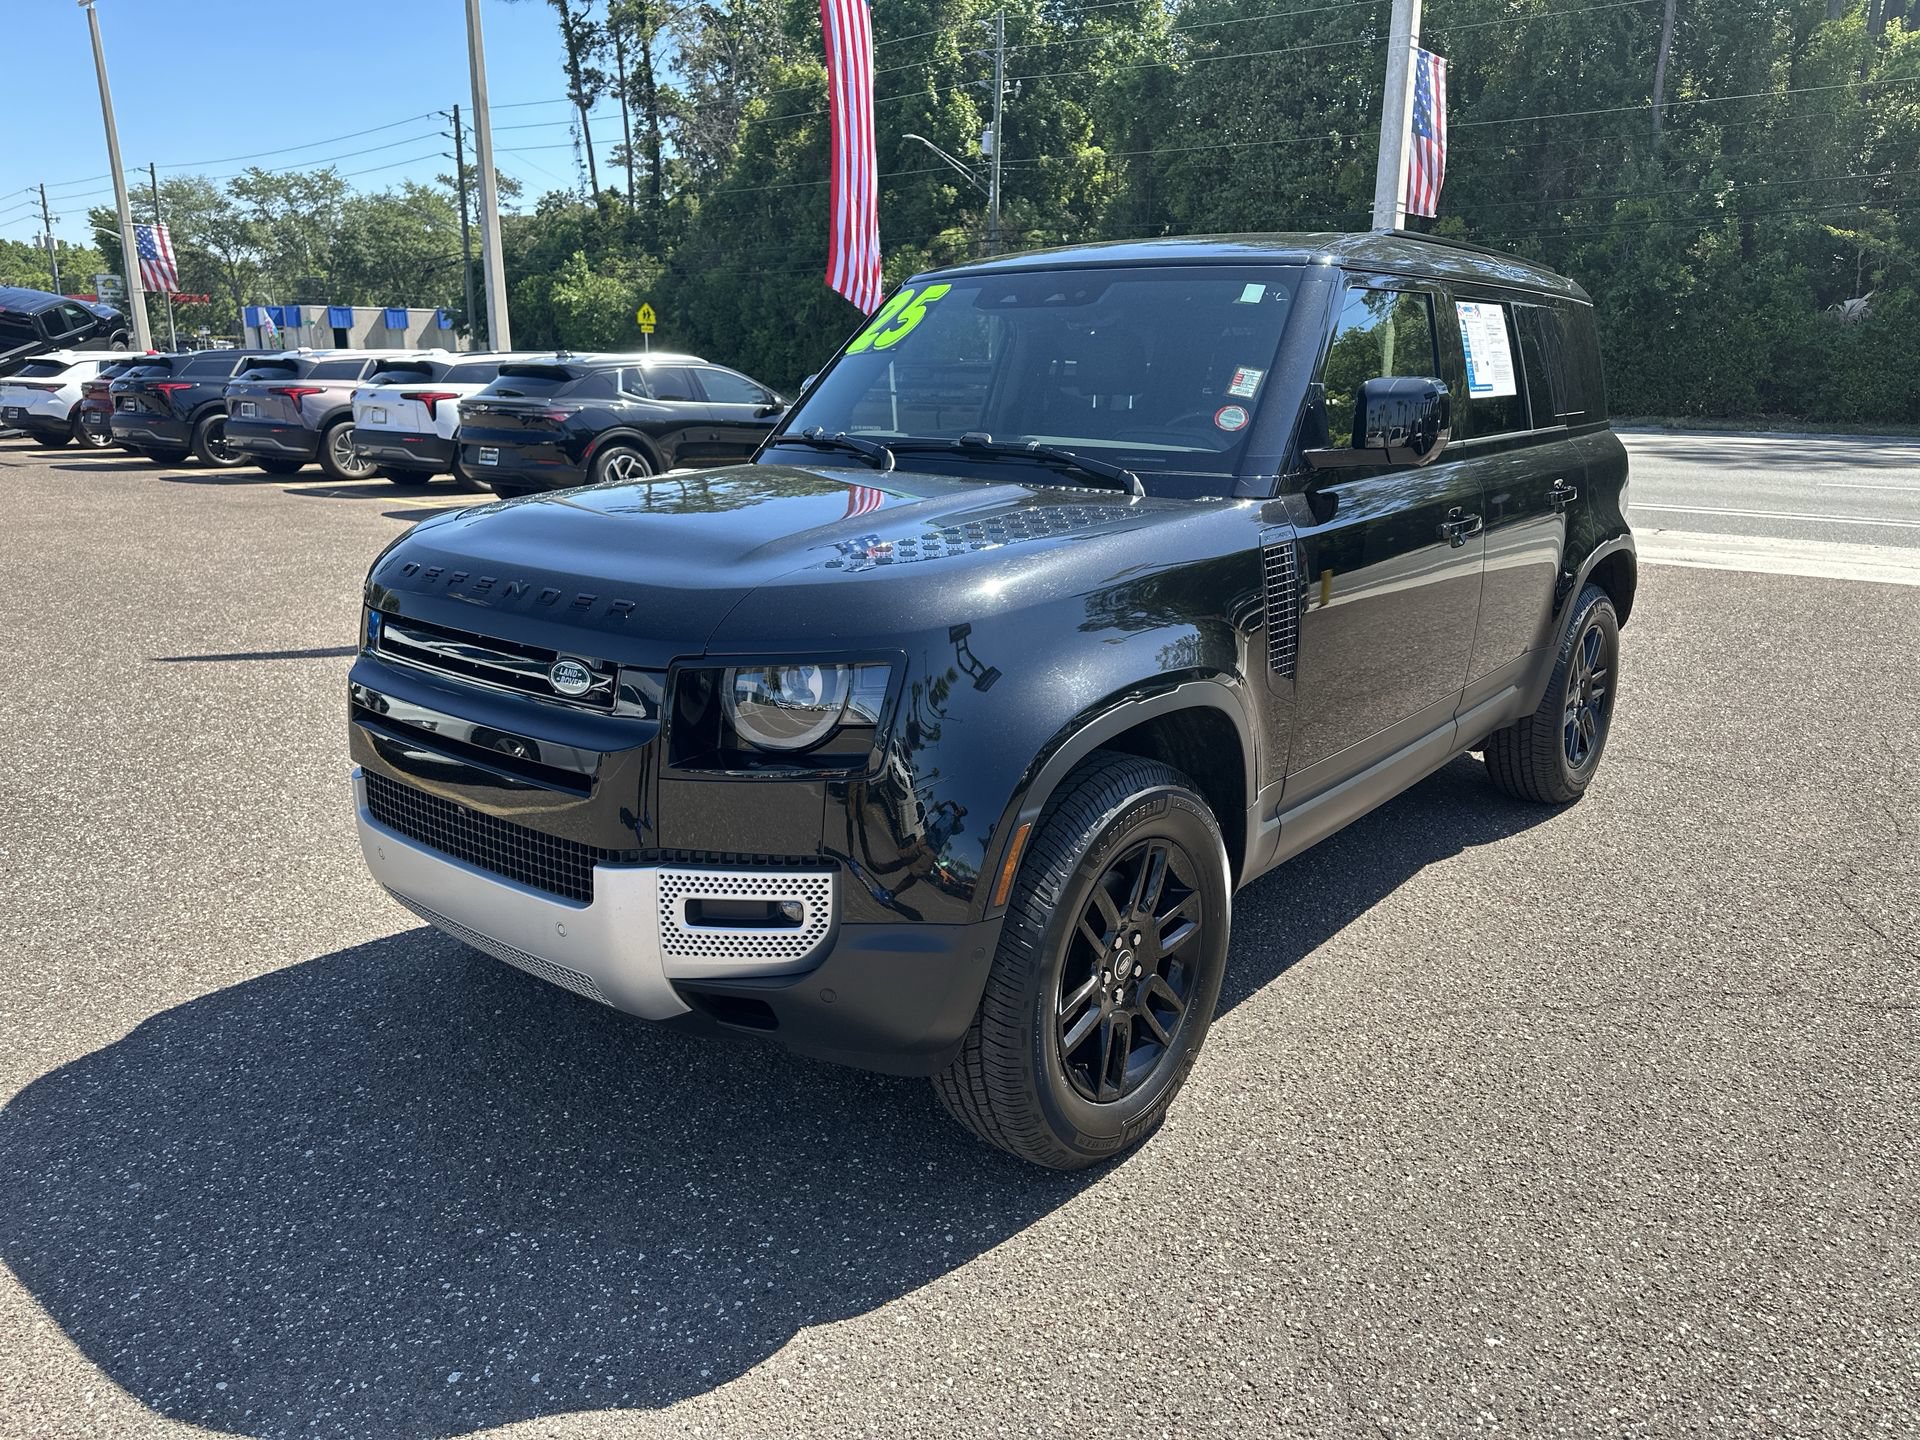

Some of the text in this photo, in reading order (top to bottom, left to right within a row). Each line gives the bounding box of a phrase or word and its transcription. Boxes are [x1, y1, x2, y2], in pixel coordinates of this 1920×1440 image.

[845, 283, 952, 355] 25
[400, 560, 636, 619] DEFENDER
[1107, 798, 1166, 847] MICHELIN
